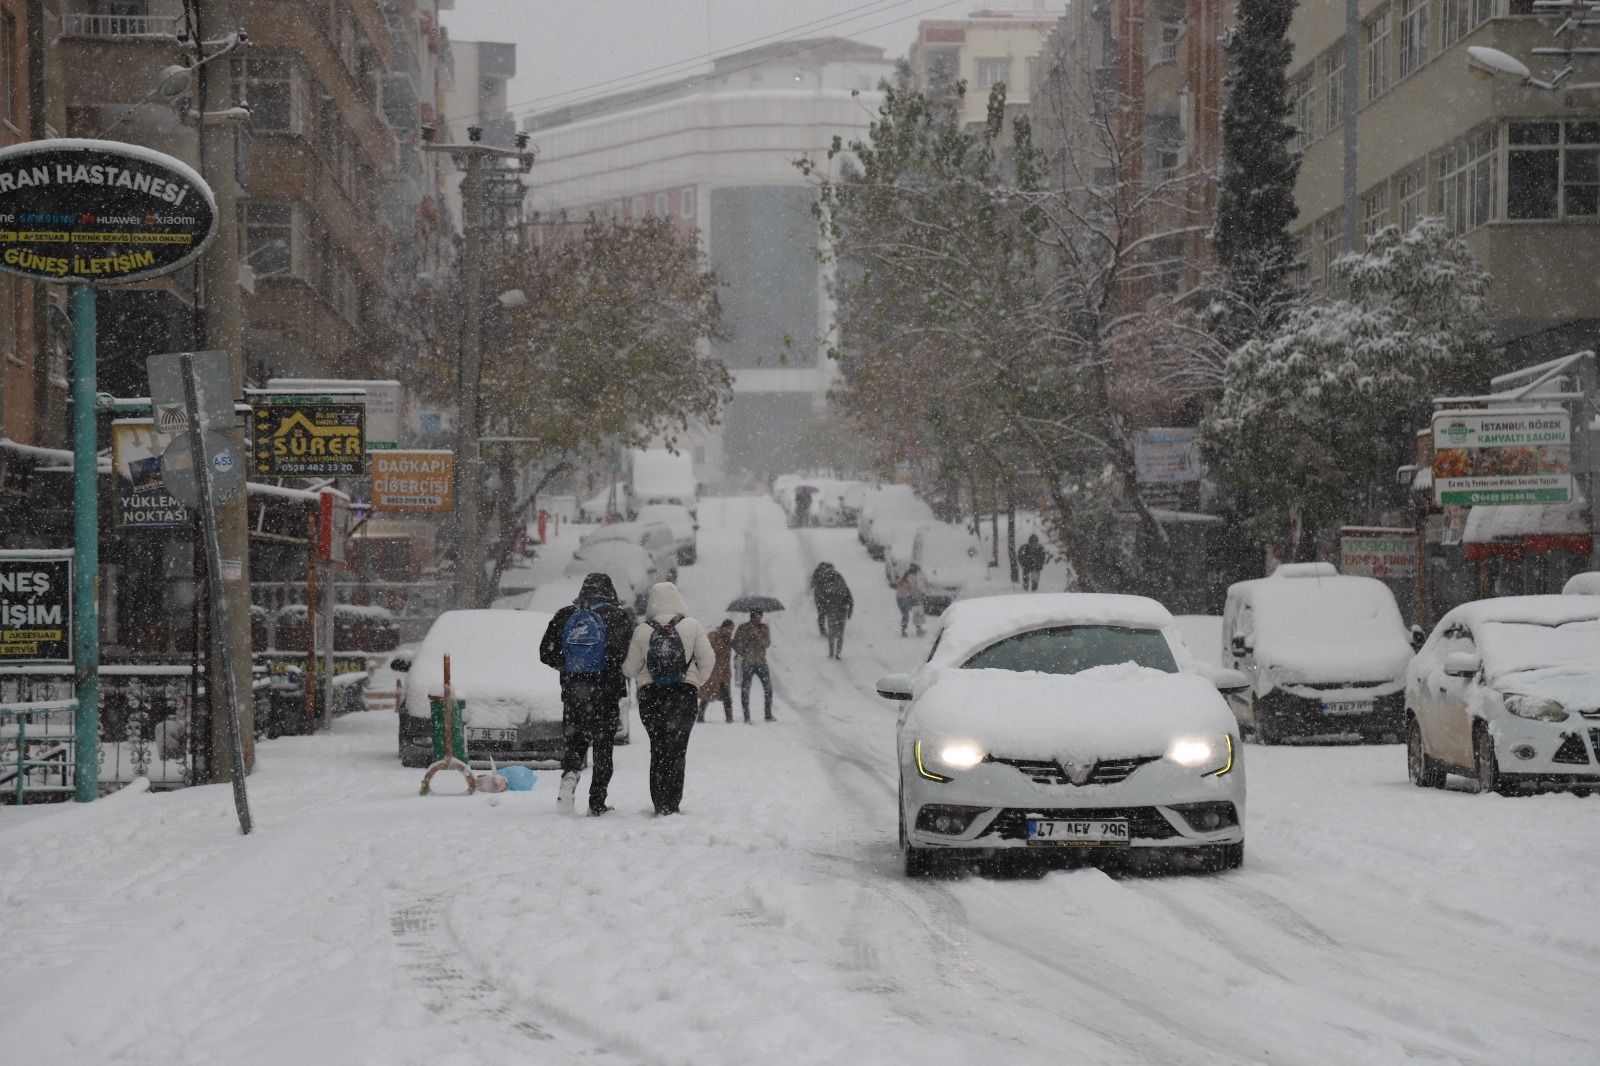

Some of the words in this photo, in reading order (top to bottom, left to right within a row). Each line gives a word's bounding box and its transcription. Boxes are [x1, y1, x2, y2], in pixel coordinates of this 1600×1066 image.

[0, 165, 50, 194] RAN
[57, 164, 190, 206] HASTANESİ
[19, 213, 76, 224] SAMSUNG
[97, 215, 140, 225] HUAWEI
[4, 247, 70, 276] GÜNEŞ
[74, 249, 155, 274] İLETİŞİM
[1480, 420, 1527, 432] İSTANBUL
[1528, 418, 1561, 430] BÖREK
[273, 430, 360, 455] SÜRER
[1478, 433, 1524, 443] KAHVALTI
[1526, 431, 1566, 442] SALONU
[214, 456, 232, 466] A-53
[378, 458, 445, 473] DAĞKAPI
[121, 494, 185, 508] YÜKLEM
[123, 510, 188, 522] NOKTASI
[0, 572, 50, 596] NEŞ
[0, 600, 61, 628] İŞİM
[1037, 822, 1054, 837] 47
